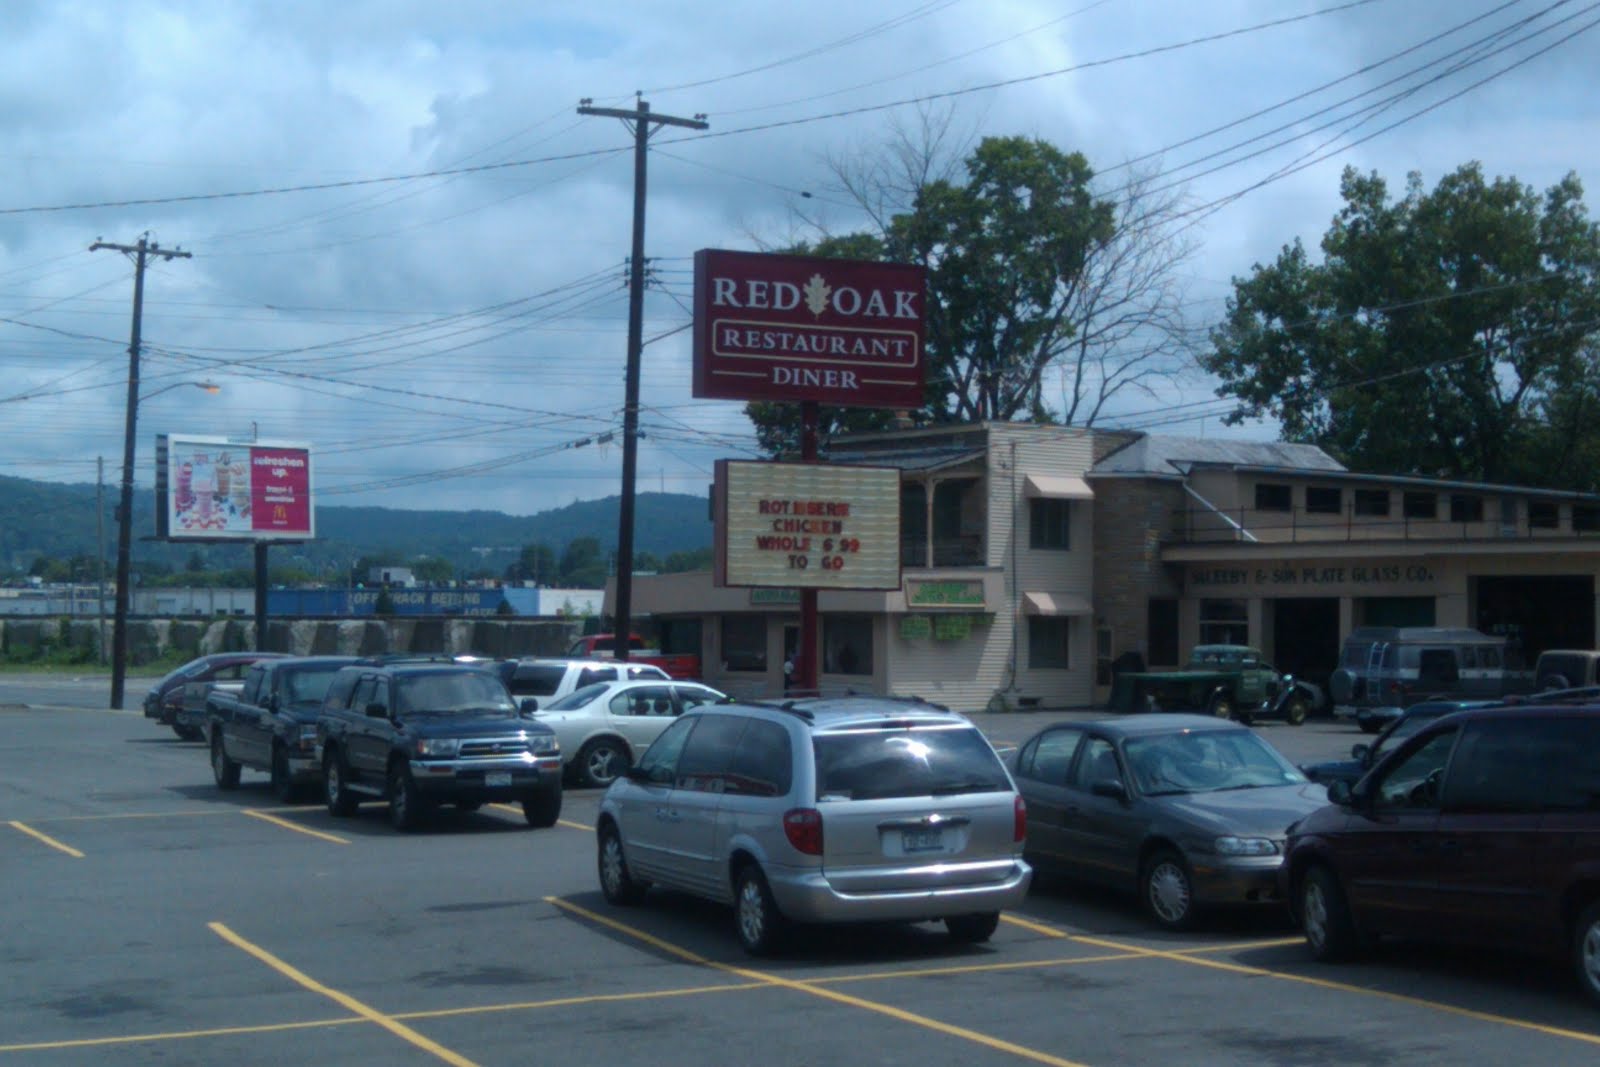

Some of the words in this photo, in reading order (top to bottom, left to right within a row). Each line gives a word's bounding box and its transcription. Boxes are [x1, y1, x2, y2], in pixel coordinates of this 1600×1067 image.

[712, 277, 800, 311] RED
[832, 287, 919, 319] OAK
[723, 329, 909, 357] RESTAURANT
[772, 366, 859, 389] DINER
[773, 518, 843, 534] CHICKEN
[757, 536, 811, 551] WHOLE
[788, 555, 809, 570] TO
[821, 555, 844, 570] GO
[1303, 567, 1345, 584] PLATE
[1352, 565, 1400, 584] GLASS
[386, 592, 426, 605] RACK
